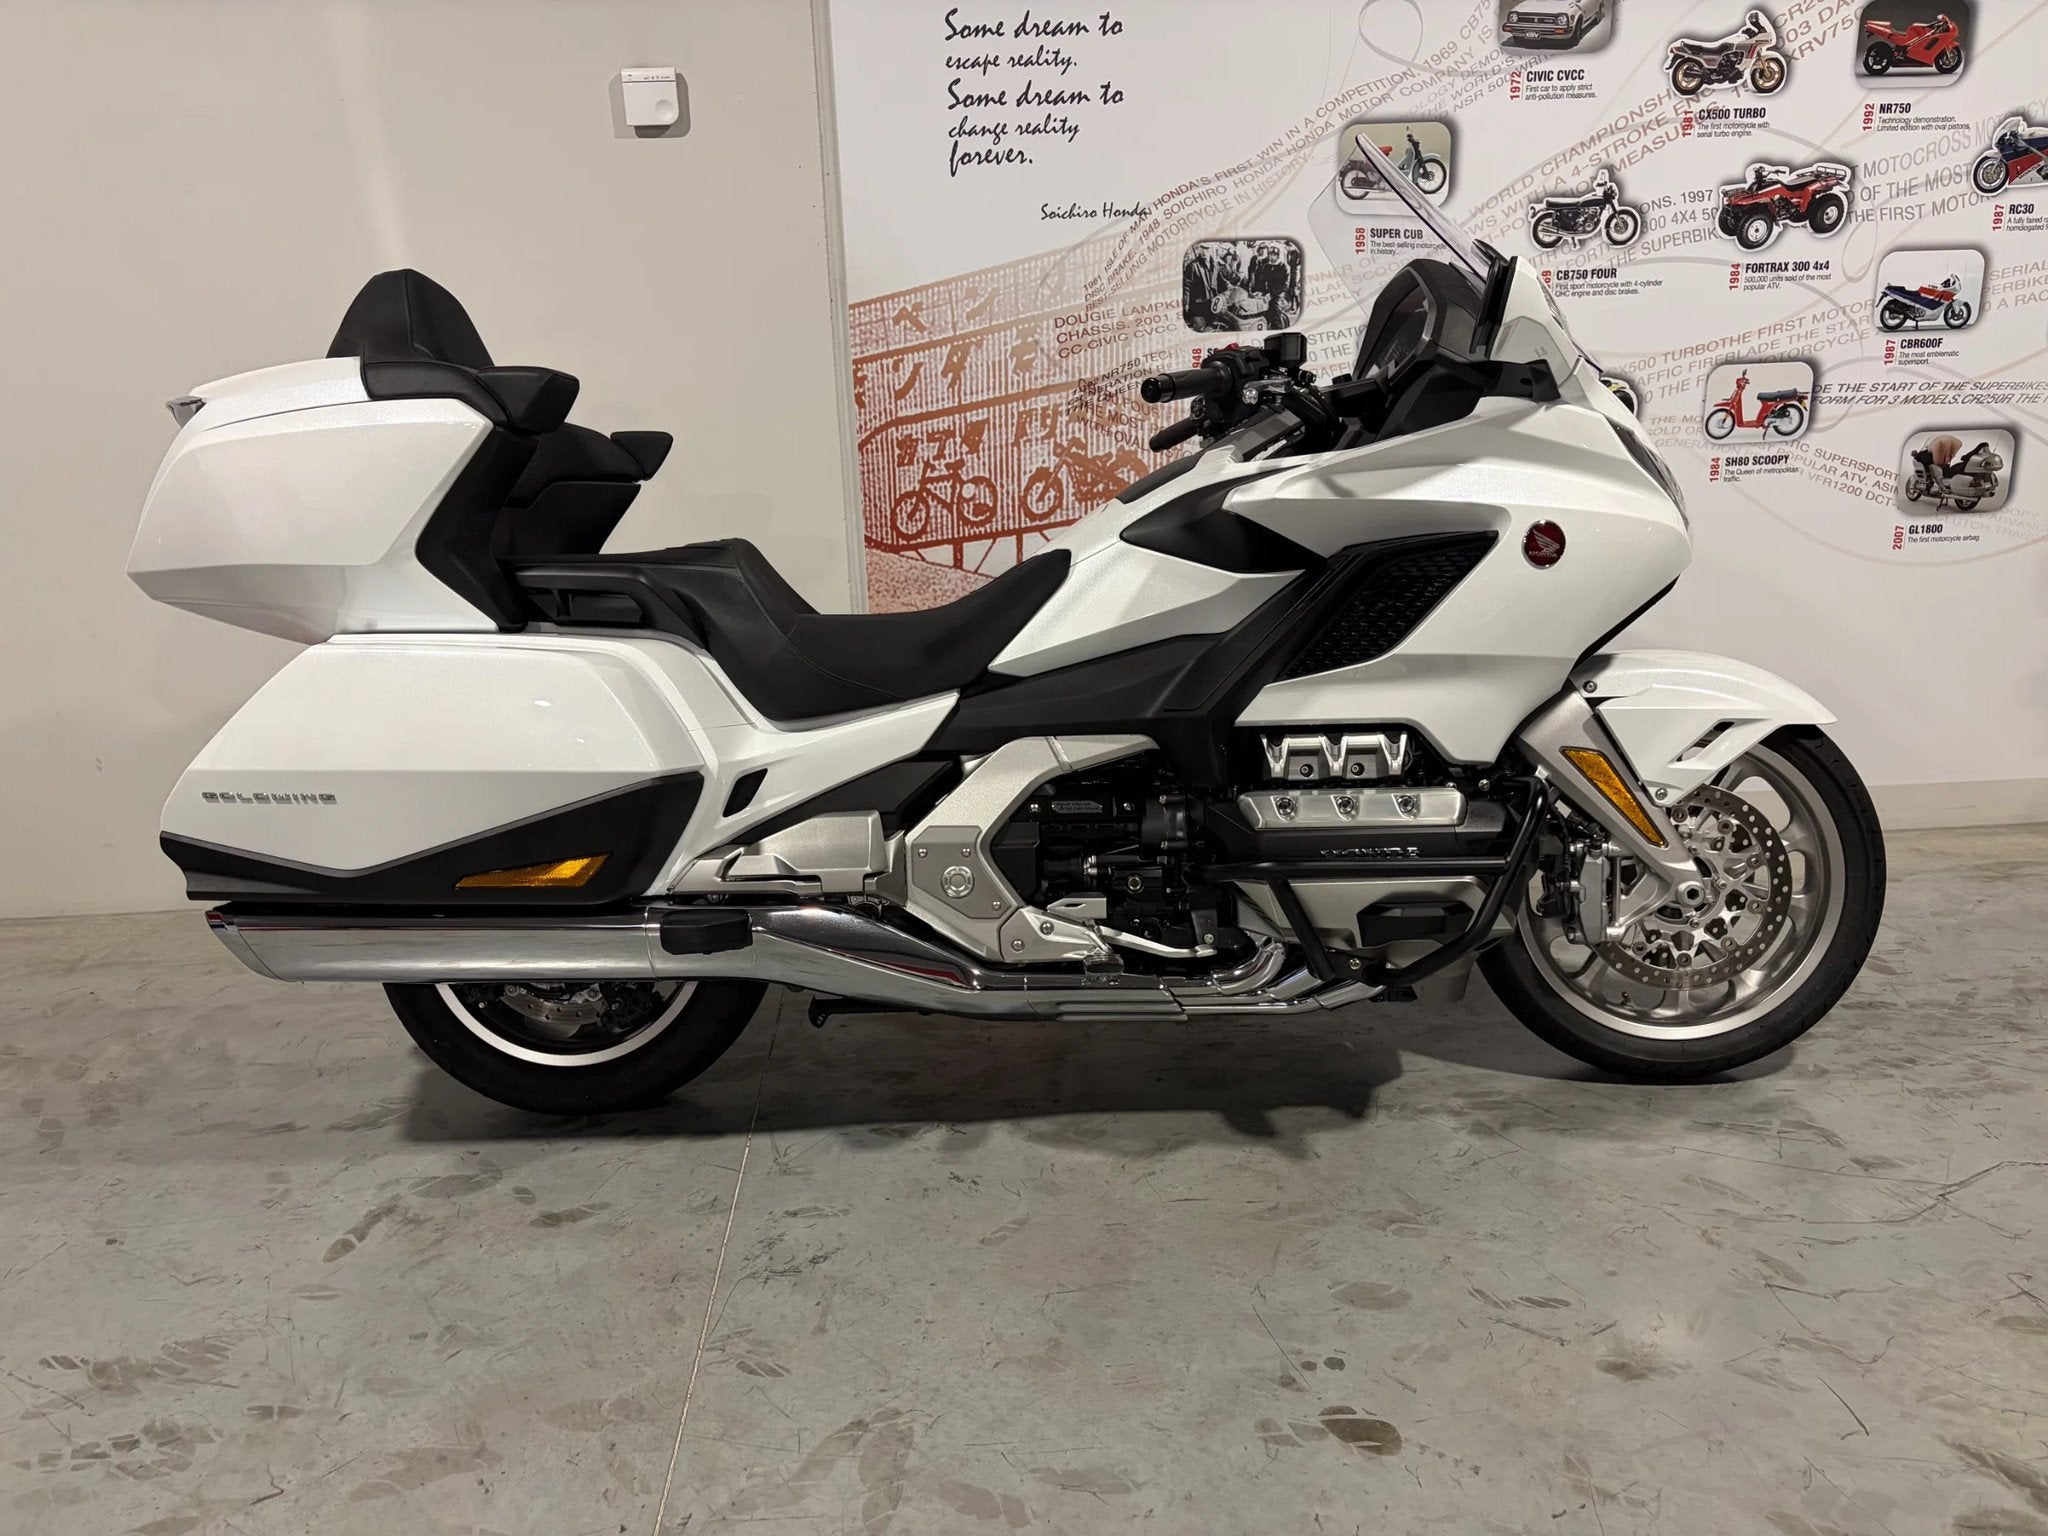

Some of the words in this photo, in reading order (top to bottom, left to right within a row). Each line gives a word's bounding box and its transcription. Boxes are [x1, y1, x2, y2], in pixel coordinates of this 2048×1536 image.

[945, 7, 1005, 41] Some
[1014, 10, 1090, 38] dream
[1098, 11, 1123, 36] to
[946, 53, 1000, 76] escape
[1007, 44, 1078, 75] reality.
[1526, 70, 1554, 82] CIVIC
[1556, 69, 1585, 81] CVCC
[947, 77, 1008, 110] Some
[1016, 79, 1091, 107] dream
[1100, 81, 1124, 105] to
[1510, 71, 1522, 100] 1972
[1559, 85, 1576, 94] apply
[1452, 90, 1484, 112] NSR
[1525, 93, 1566, 101] anti-pollution
[1699, 108, 1730, 120] CX500
[1733, 107, 1766, 119] TURBO
[1863, 103, 1875, 131] 1992
[1879, 103, 1911, 114] NR750
[948, 115, 1008, 145] change
[1015, 113, 1079, 143] reality
[1152, 175, 1211, 210] HONDA'S
[1214, 158, 1254, 182] FIRST
[1256, 138, 1284, 161] WIN
[1285, 125, 1301, 141] IN
[1304, 117, 1315, 129] A
[1315, 67, 1421, 118] COMPETITION.
[1423, 41, 1458, 69] 1969
[1682, 110, 1694, 137] 1981
[1698, 122, 1709, 130] The
[1710, 122, 1721, 130] first
[1723, 122, 1757, 131] motorcycle
[1878, 117, 1912, 125] Technology
[1900, 123, 1920, 131] edition
[1949, 123, 1971, 131] pistons.
[1138, 218, 1160, 244] 1948
[1163, 184, 1227, 221] SOICHIRO
[1233, 156, 1283, 189] HONDA
[1285, 121, 1335, 156] HONDA
[1338, 93, 1394, 121] MOTOR
[1400, 46, 1474, 97] COMPANY
[1554, 175, 1567, 191] A
[1571, 110, 1669, 178] 4-STROKE
[1863, 130, 1972, 179] MOTOCROSS
[949, 139, 1033, 177] forever.
[1860, 185, 1881, 203] OF
[1886, 177, 1919, 200] THE
[1925, 162, 1973, 192] MOST
[1469, 176, 1534, 217] WORLD
[1681, 189, 1713, 204] 1997
[1041, 202, 1097, 220] Soichiro
[1102, 201, 1148, 219] Honda
[1671, 209, 1697, 226] 4X4
[1880, 204, 1926, 221] FIRST
[1993, 205, 2004, 231] 1987
[2008, 204, 2034, 214] RC30
[1147, 198, 1234, 255] MOTORCYCLE
[1235, 190, 1249, 205] IN
[1355, 228, 1365, 255] 1958
[1370, 228, 1400, 239] SUPER
[1403, 229, 1423, 239] CUB
[1382, 241, 1416, 250] best-selling
[1556, 269, 1588, 280] CB750
[1591, 268, 1617, 279] FOUR
[1729, 263, 1741, 290] 1984
[1745, 261, 1789, 274] FORTRAX
[1792, 261, 1810, 272] 300
[1812, 260, 1830, 271] 4x4
[1571, 290, 1591, 298] engine
[1586, 281, 1619, 289] motorcycle
[1744, 283, 1766, 291] popular
[1767, 282, 1781, 290] ATV.
[1054, 309, 1116, 328] DOUGIE
[1056, 320, 1131, 344] CHASSIS.
[1136, 314, 1169, 329] 2001
[1756, 316, 1807, 342] FIRST
[1787, 327, 1820, 346] THE
[1058, 332, 1129, 359] CC.CIVIC
[1133, 323, 1178, 339] CVCC
[1900, 337, 1943, 349] CBR600F
[1325, 343, 1353, 361] THE
[1884, 339, 1896, 365] 1987
[1927, 350, 1960, 358] emblematic
[1101, 357, 1141, 382] NR750
[1658, 380, 1691, 401] THE
[1835, 382, 1865, 393] THE
[1869, 382, 1917, 393] START
[1919, 381, 1940, 391] OF
[1942, 381, 1970, 391] THE
[1854, 395, 1885, 405] FOR
[1885, 395, 1901, 405] 3
[2015, 394, 2043, 404] THE
[1709, 457, 1721, 482] 1984
[1725, 456, 1749, 467] SH80
[1752, 455, 1790, 465] SCOOPY
[1808, 471, 1863, 498] VFR1200
[1839, 470, 1869, 487] ATV.
[1892, 526, 1904, 550] 2007
[1908, 524, 1943, 535] GL1800
[1931, 535, 1961, 543] motorcycle
